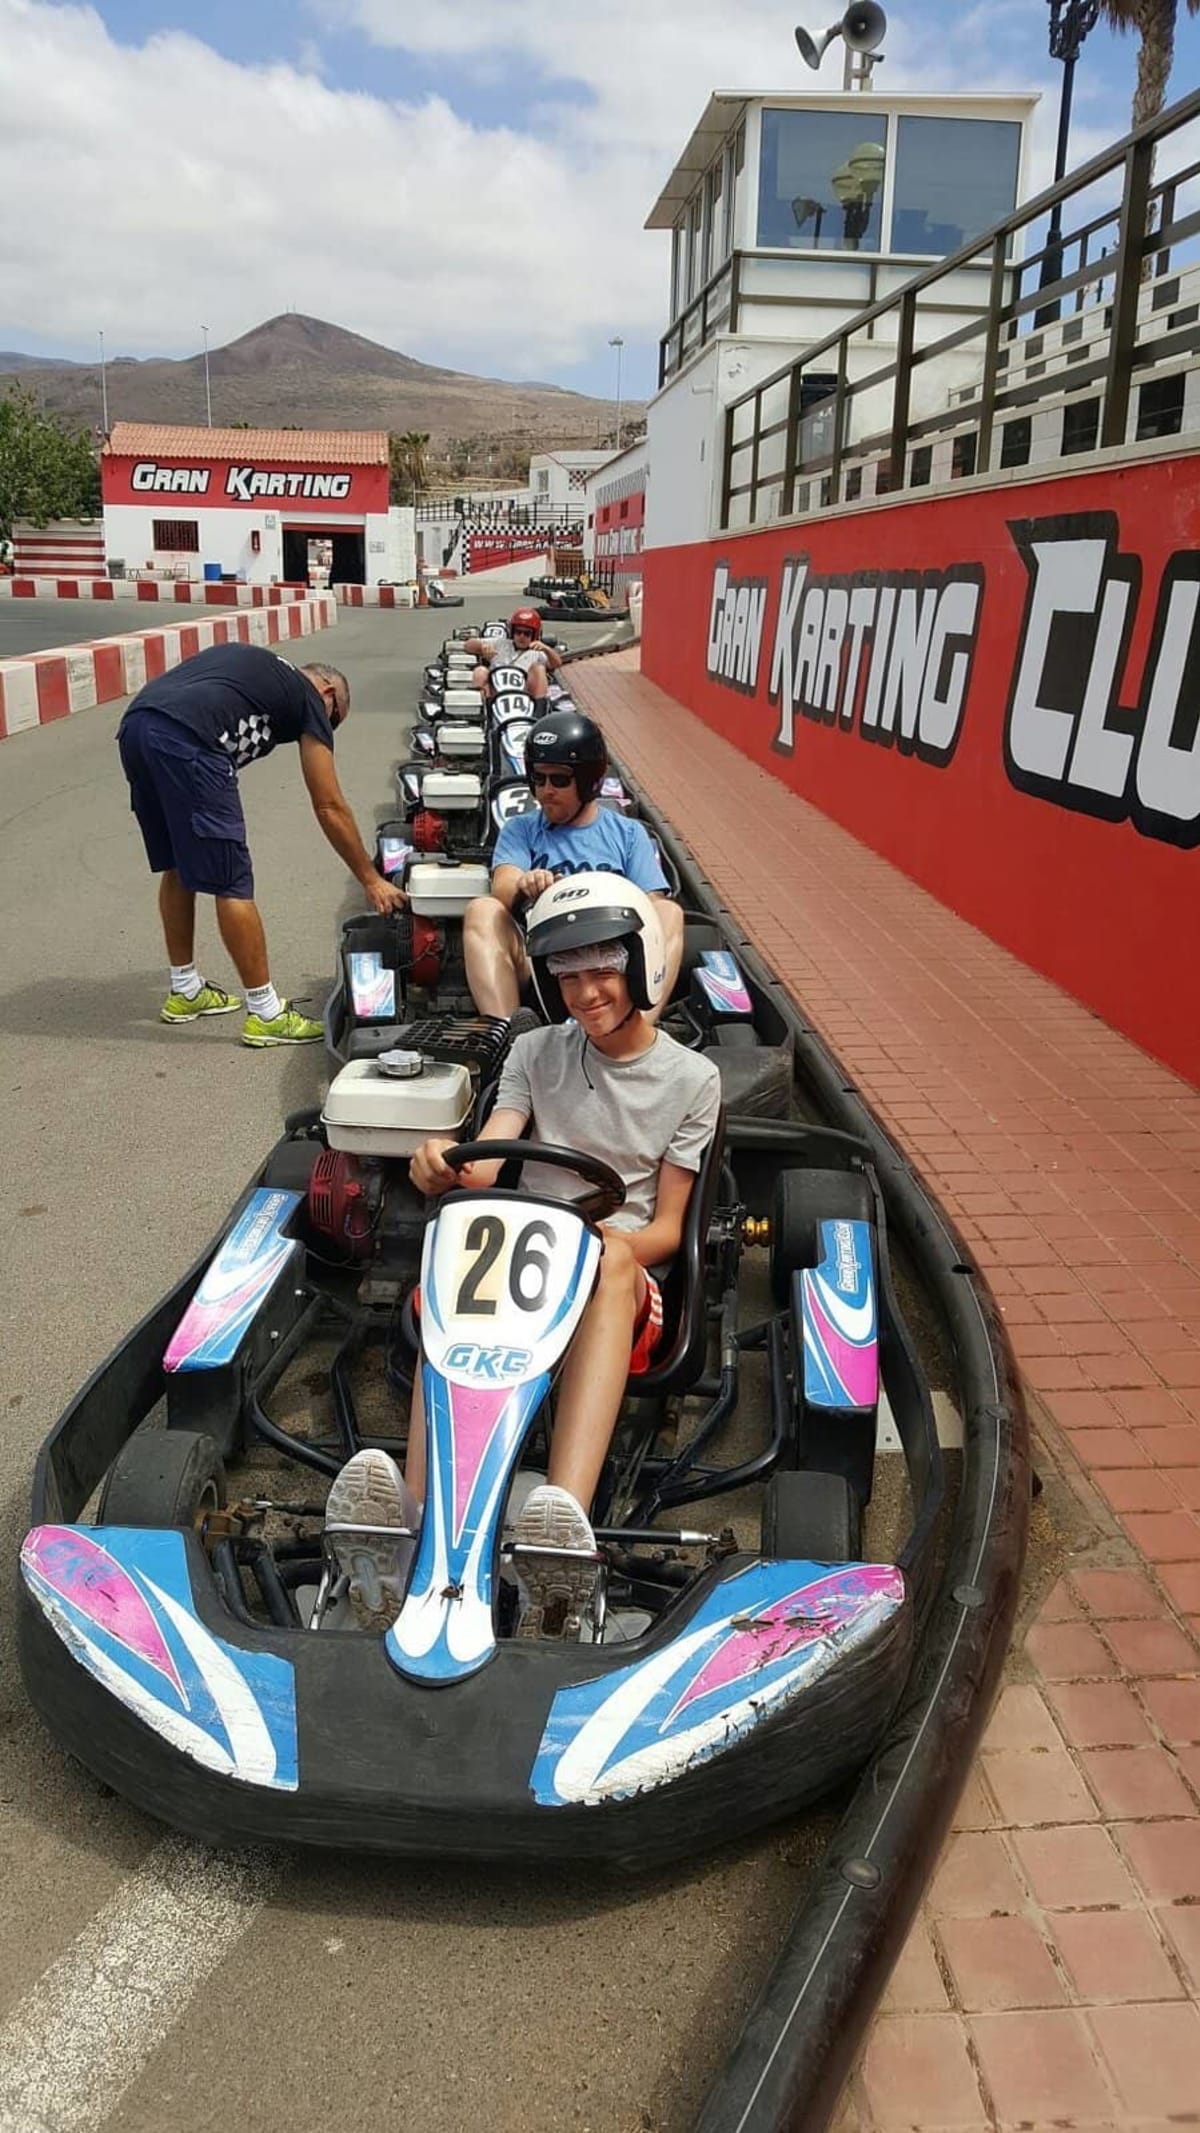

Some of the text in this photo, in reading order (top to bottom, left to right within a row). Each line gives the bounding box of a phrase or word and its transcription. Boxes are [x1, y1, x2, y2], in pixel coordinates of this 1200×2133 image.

[131, 462, 352, 501] GRAN KARTING
[706, 561, 767, 694] GRAN
[769, 553, 984, 756] KARTING
[499, 671, 523, 688] 16
[499, 697, 526, 713] 14
[454, 1215, 558, 1316] 26
[441, 1342, 534, 1381] GKC
